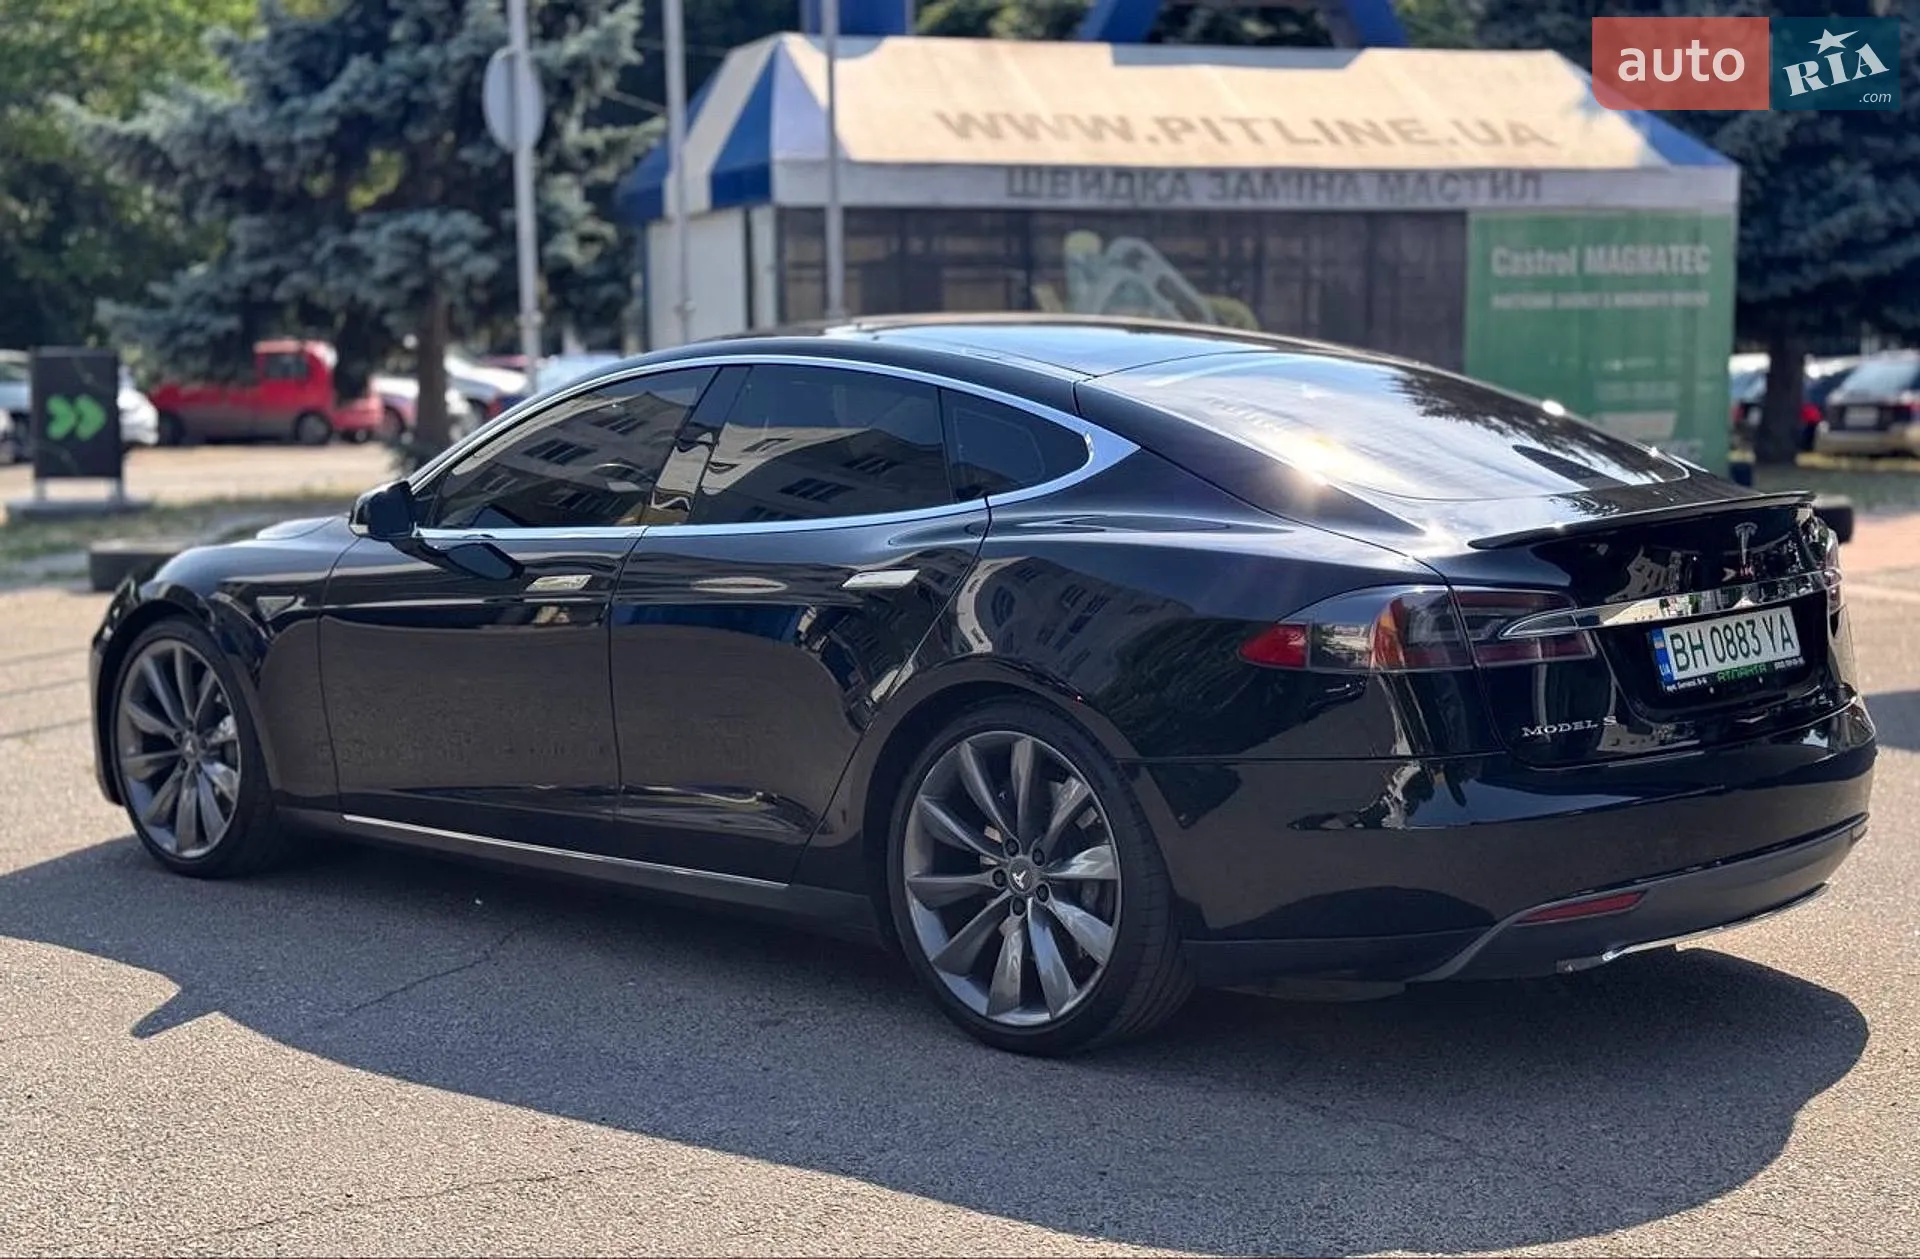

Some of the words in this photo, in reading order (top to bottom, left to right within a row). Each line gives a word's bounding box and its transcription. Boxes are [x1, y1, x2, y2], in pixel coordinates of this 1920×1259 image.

[934, 110, 1558, 149] WWW.PITLINE.UA
[1005, 166, 1193, 205] ШВИДКА
[1377, 169, 1543, 204] МАСТИЛ
[1491, 246, 1578, 276] Castrol
[1669, 628, 1709, 672] BH
[1710, 619, 1762, 664] 0883
[1521, 719, 1599, 737] MODEL
